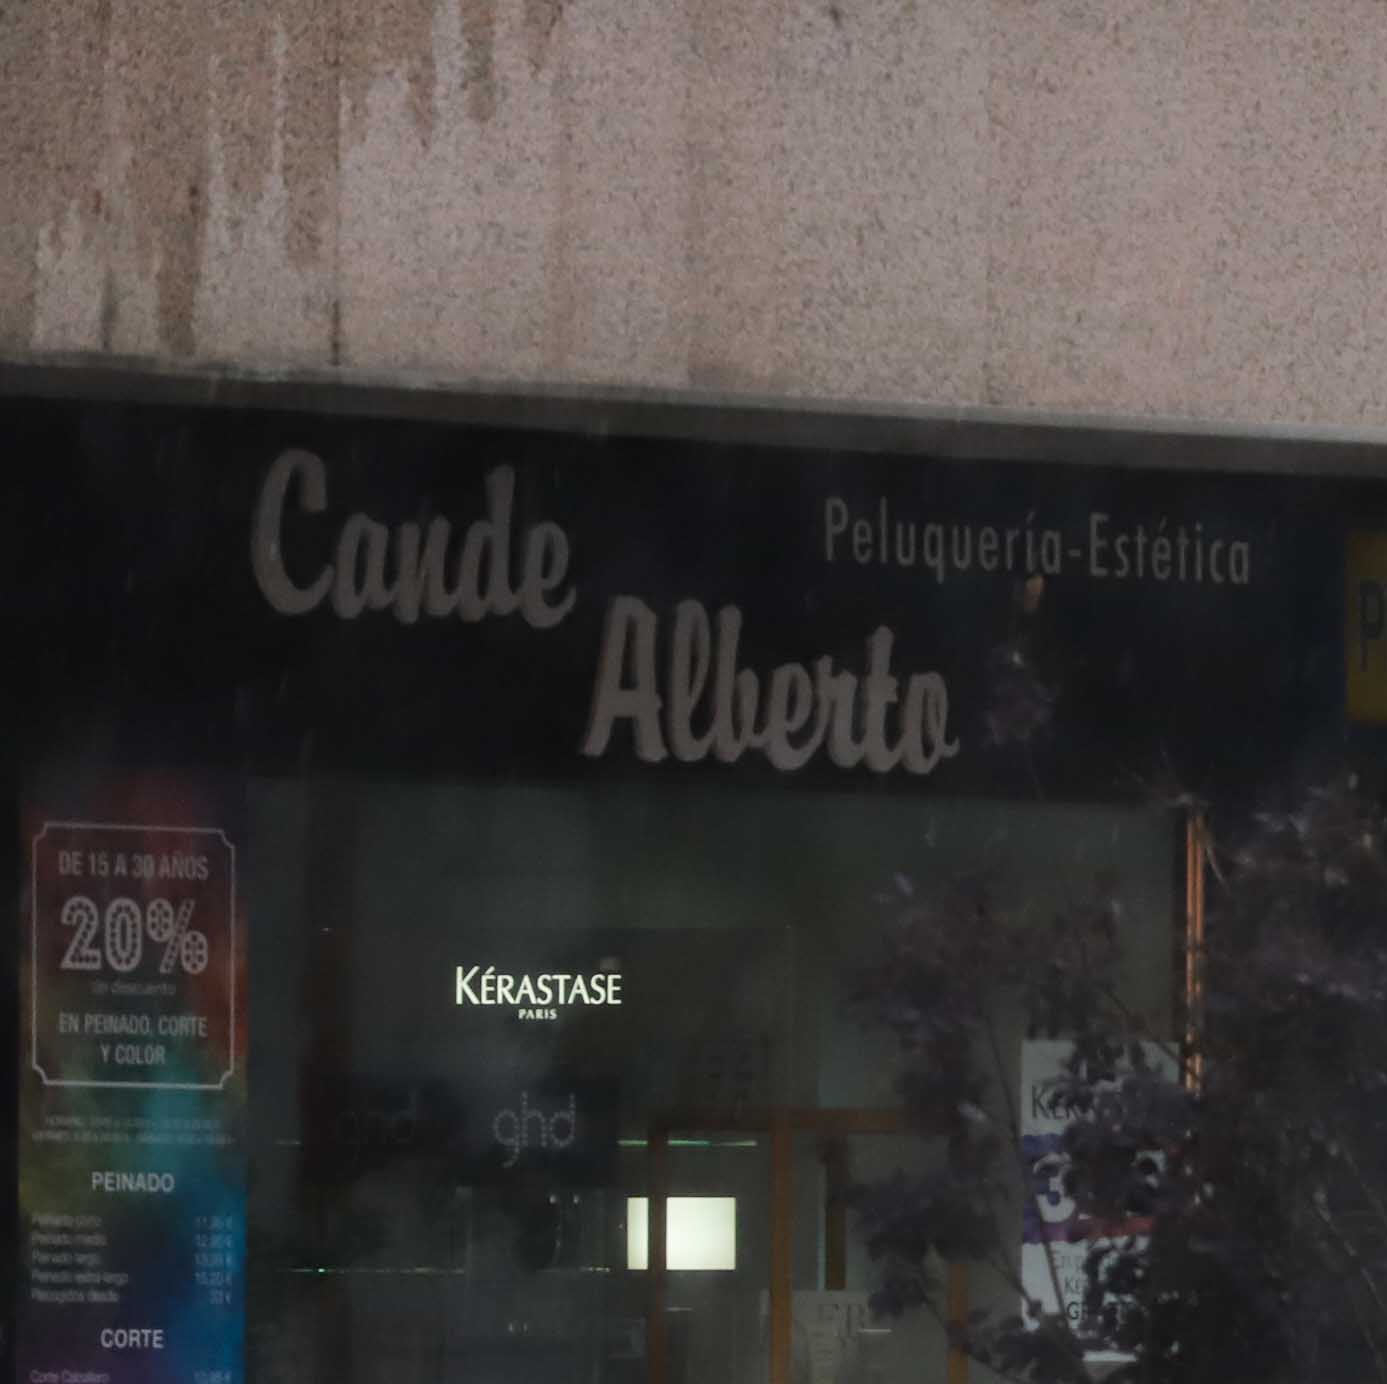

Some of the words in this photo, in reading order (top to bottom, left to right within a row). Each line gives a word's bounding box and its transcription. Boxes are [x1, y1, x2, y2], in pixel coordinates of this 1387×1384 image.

[249, 448, 577, 629] Cande
[823, 497, 1250, 585] Peluquería-Estética
[578, 596, 961, 775] Alberto
[58, 851, 84, 876] DE
[60, 896, 209, 975] 20%
[455, 966, 622, 1005] KÉRASTASE
[58, 1012, 79, 1033] EN
[157, 1015, 208, 1038] CORTE
[518, 1008, 557, 1020] PARIS
[115, 1044, 166, 1065] COLOR
[492, 1090, 576, 1168] ghd
[91, 1171, 175, 1193] PEINADO
[100, 1328, 165, 1349] CORTE
